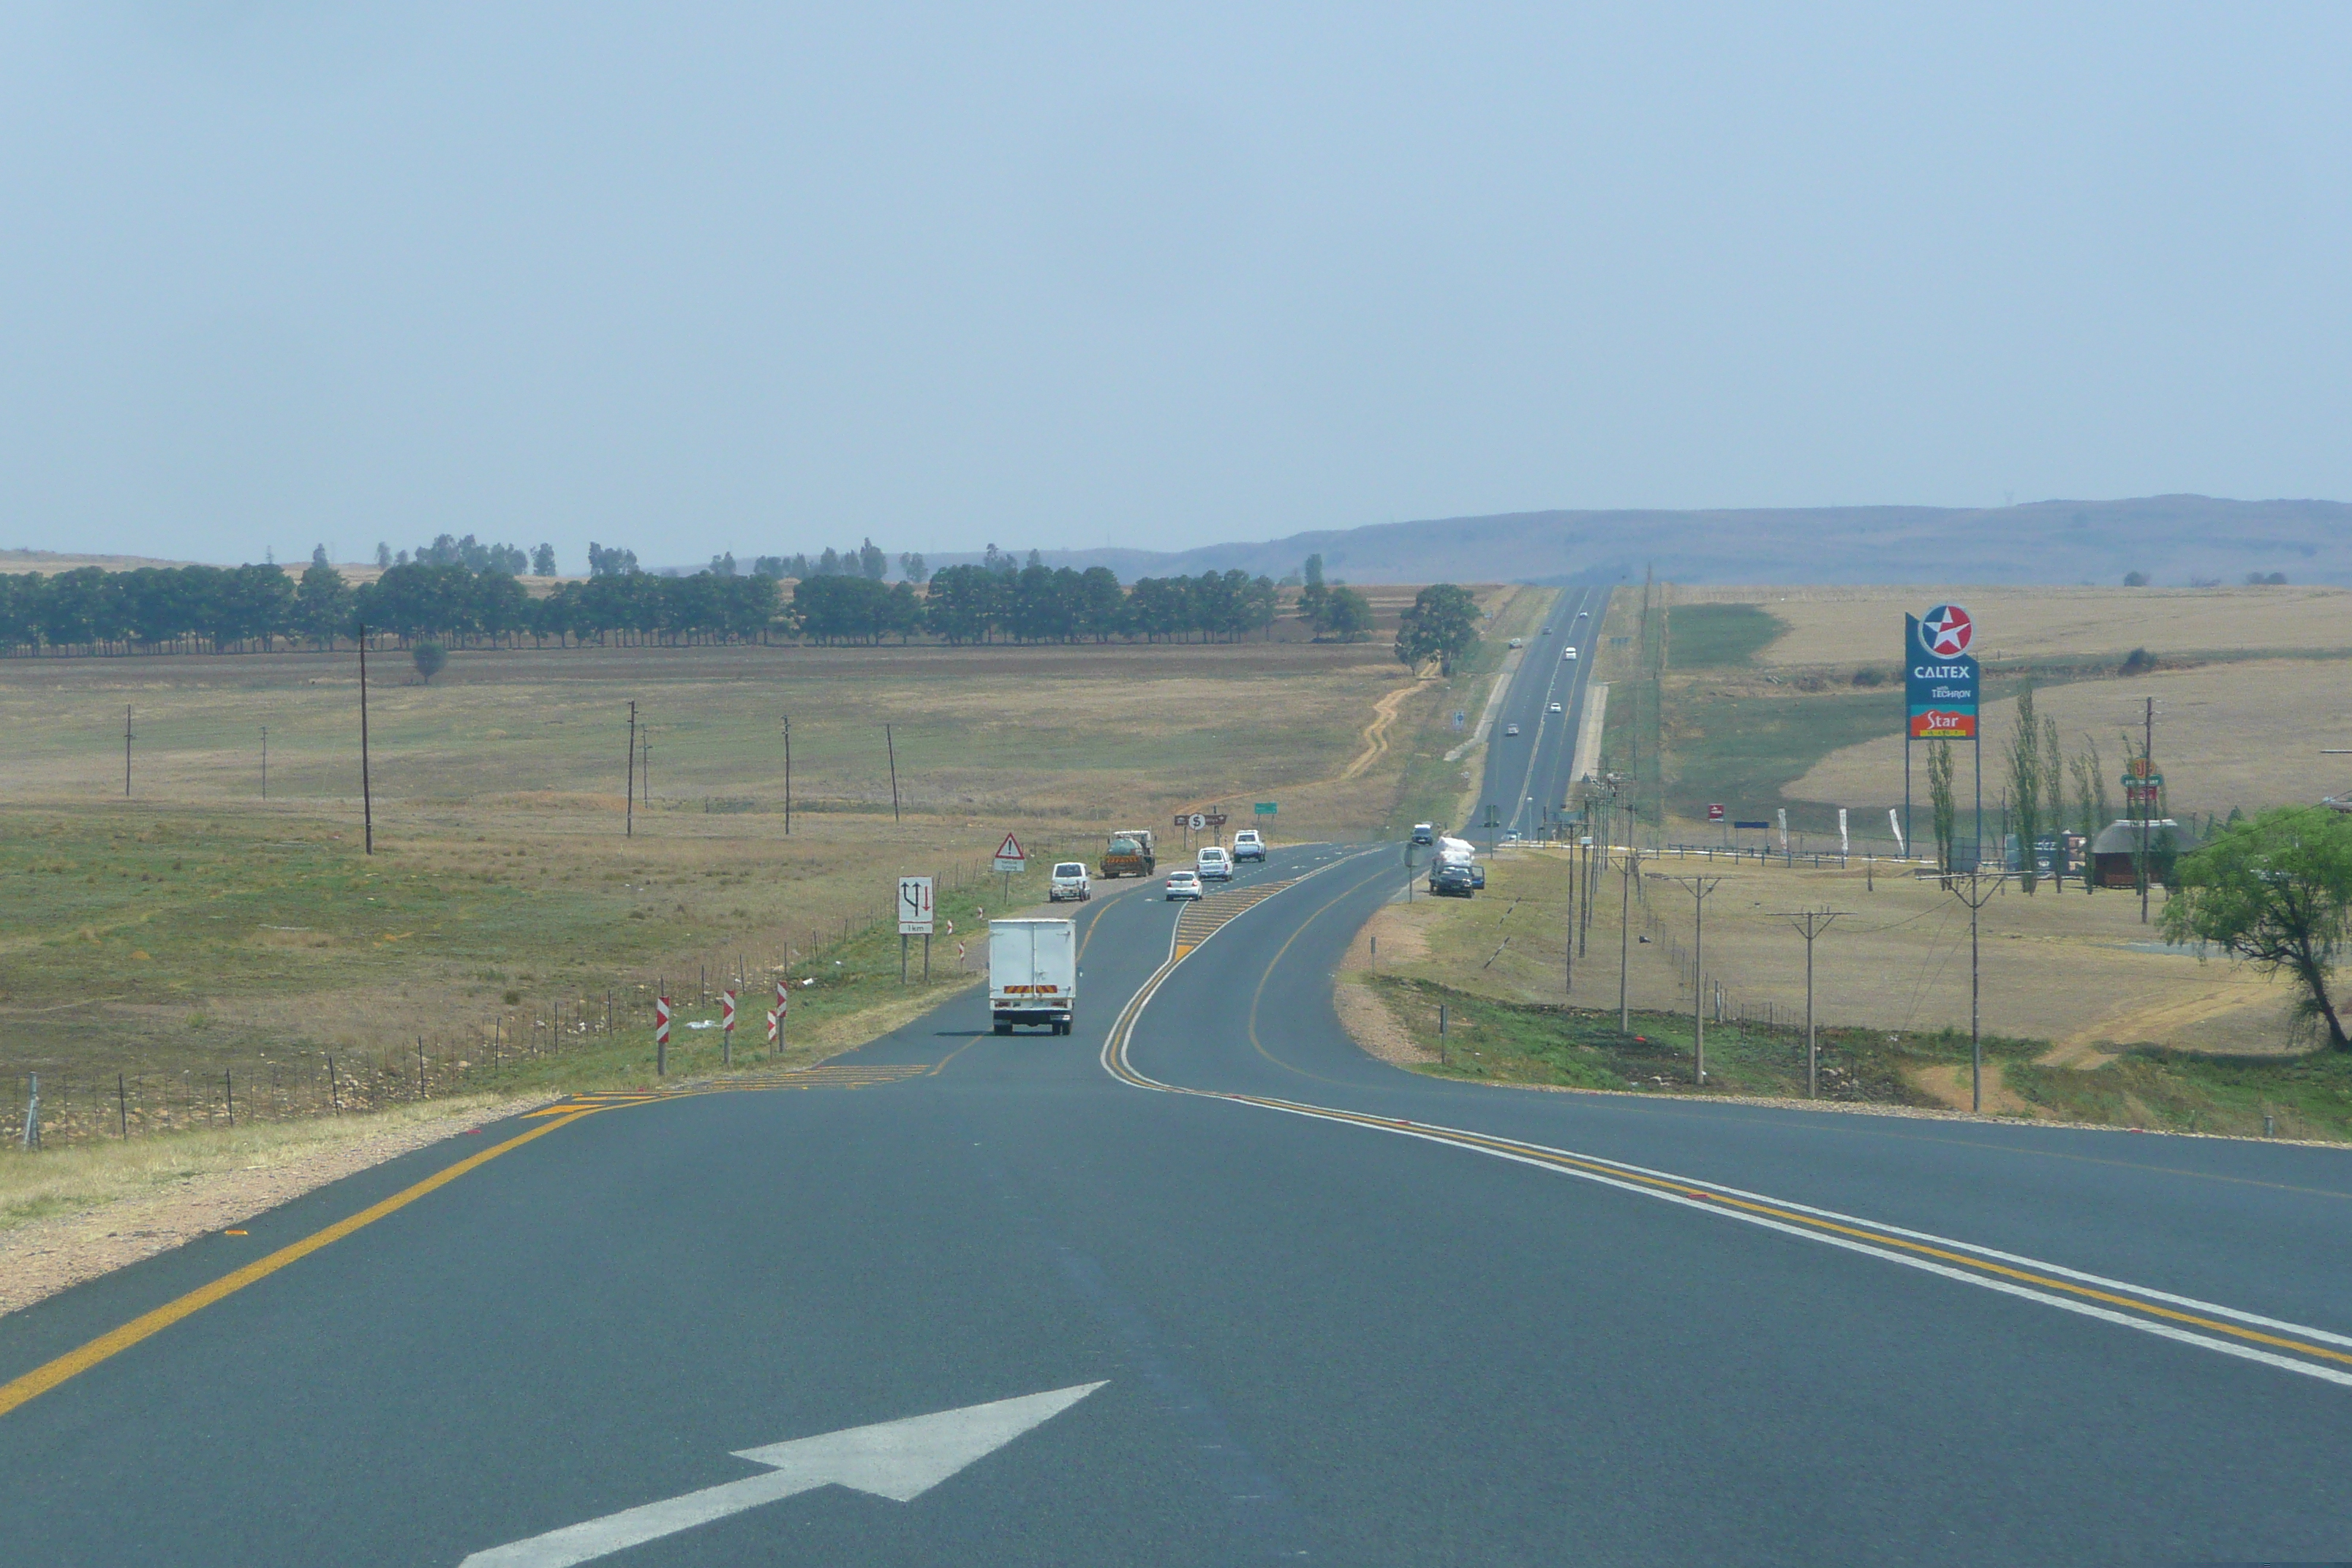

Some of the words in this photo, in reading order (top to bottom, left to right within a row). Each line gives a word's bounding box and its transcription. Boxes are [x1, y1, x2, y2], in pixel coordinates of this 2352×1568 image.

[1914, 666, 1970, 678] CALTEX
[1931, 690, 1971, 698] TECHRON
[1927, 711, 1959, 730] Star
